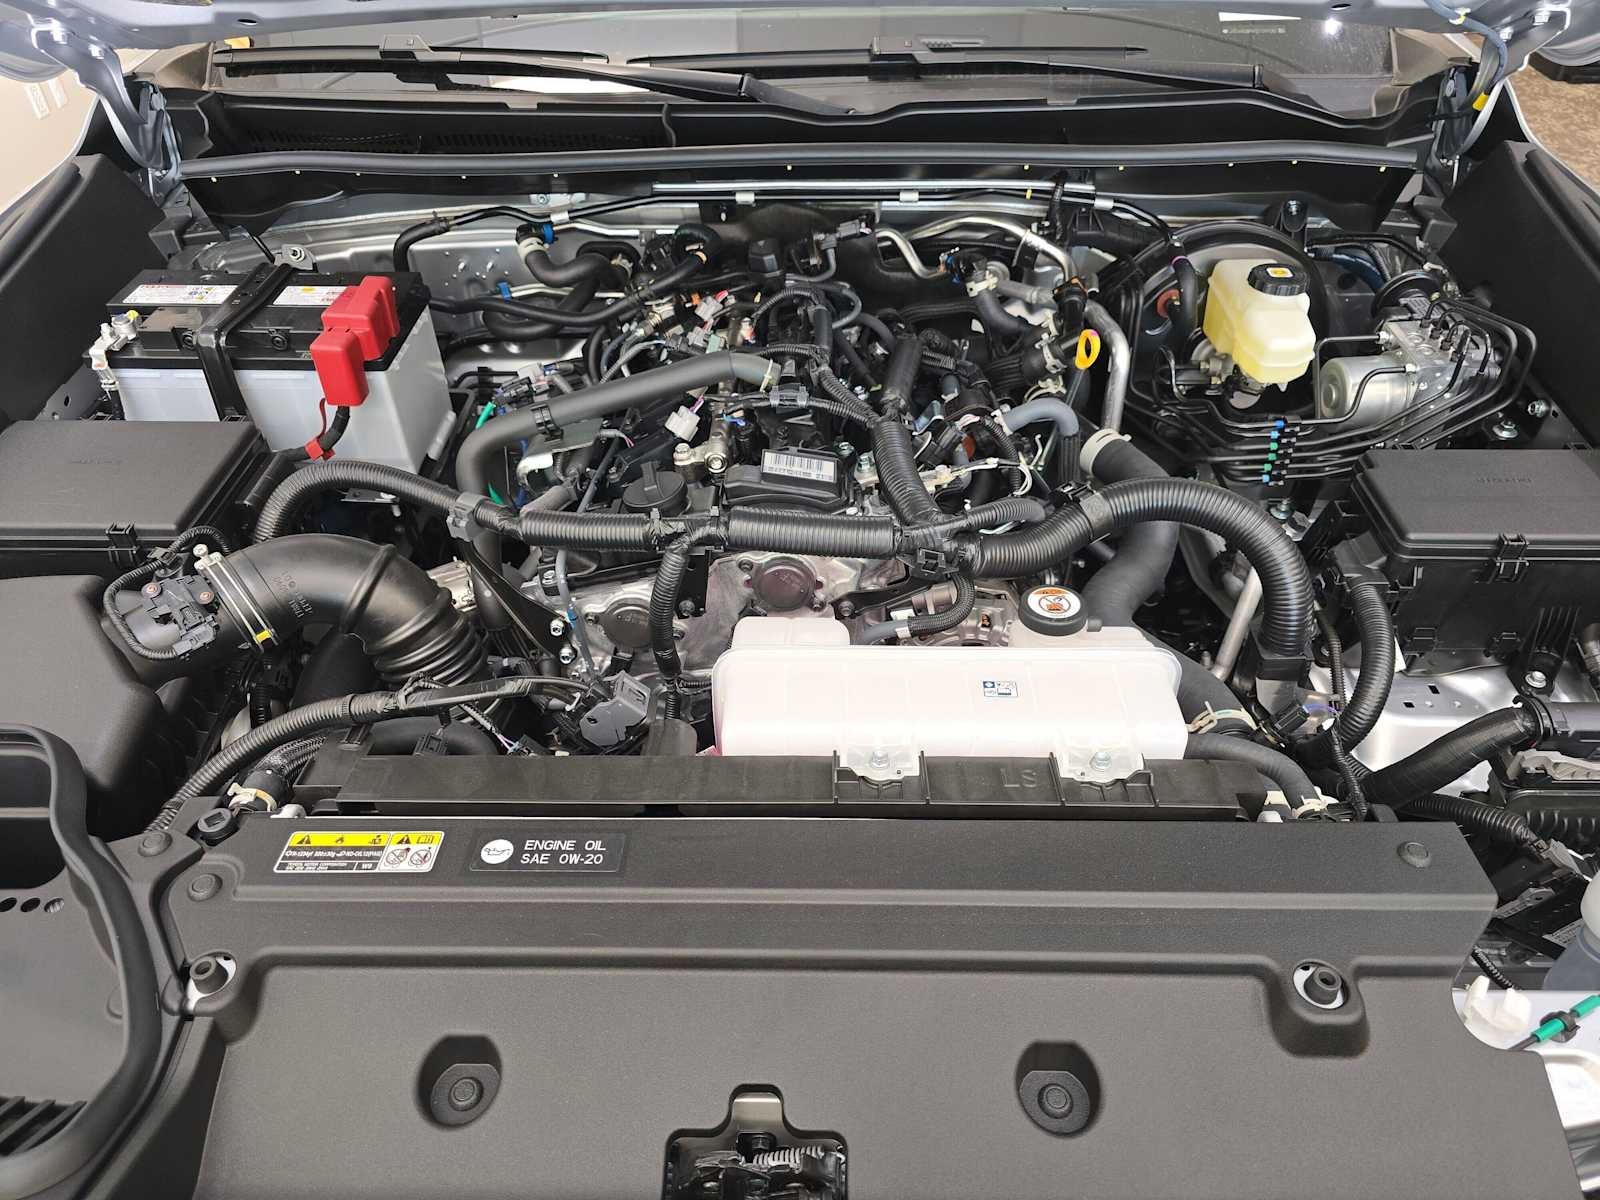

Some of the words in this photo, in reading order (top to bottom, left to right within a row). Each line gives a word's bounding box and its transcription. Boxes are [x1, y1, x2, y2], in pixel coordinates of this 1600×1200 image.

[523, 839, 577, 851] ENGINE
[584, 839, 607, 851] OIL
[520, 853, 551, 865] SAE
[558, 853, 604, 865] 0W-20
